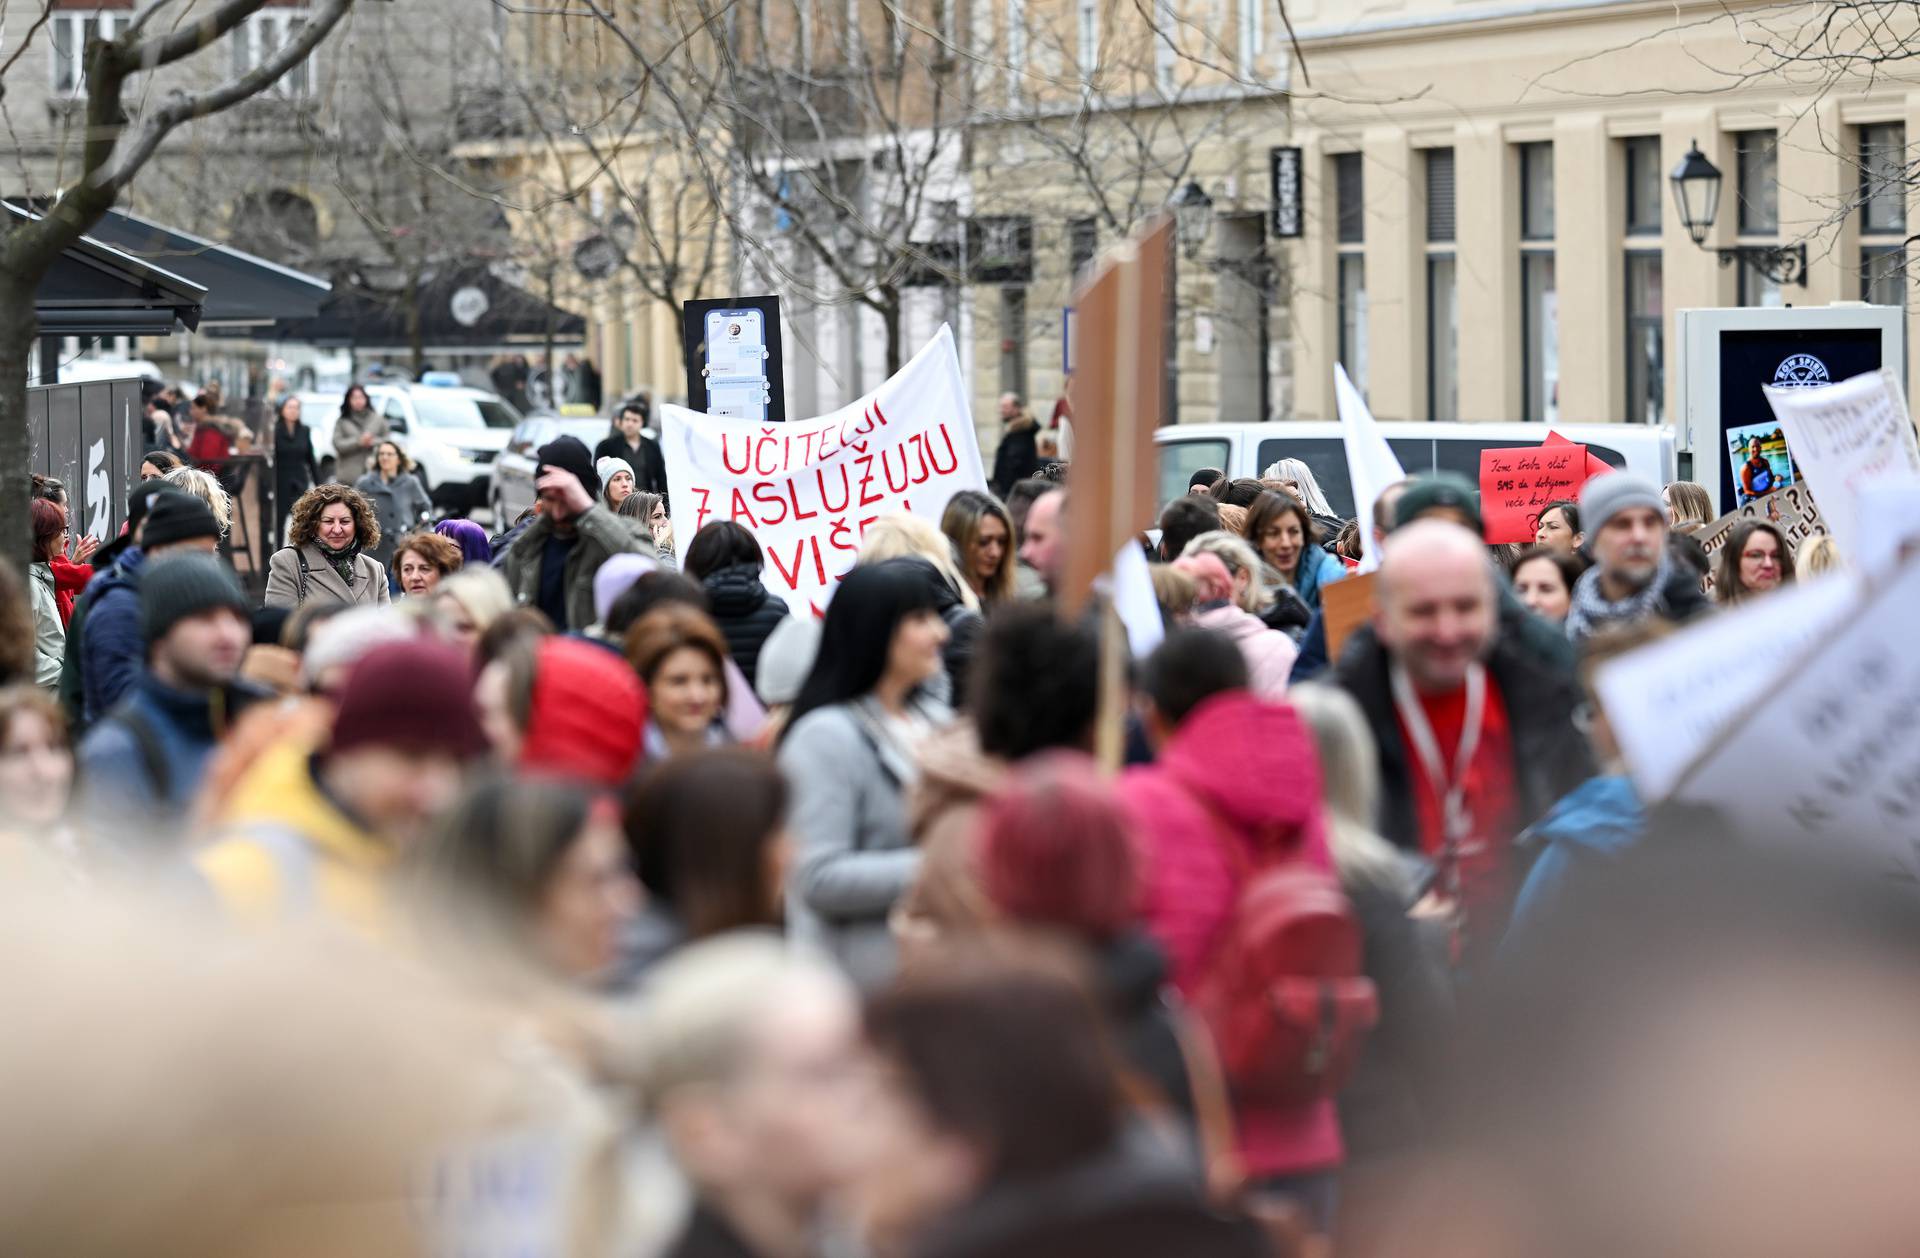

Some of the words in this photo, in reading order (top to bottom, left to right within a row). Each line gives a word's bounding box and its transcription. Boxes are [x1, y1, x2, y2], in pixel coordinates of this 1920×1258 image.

[1799, 357, 1826, 378] SPIRIT
[722, 398, 888, 476] UČITELJI
[1517, 456, 1540, 470] treba
[691, 423, 958, 531] ZASLUŽUJU
[1497, 480, 1514, 491] SMS
[1518, 478, 1528, 489] da
[1786, 489, 1801, 511] ?
